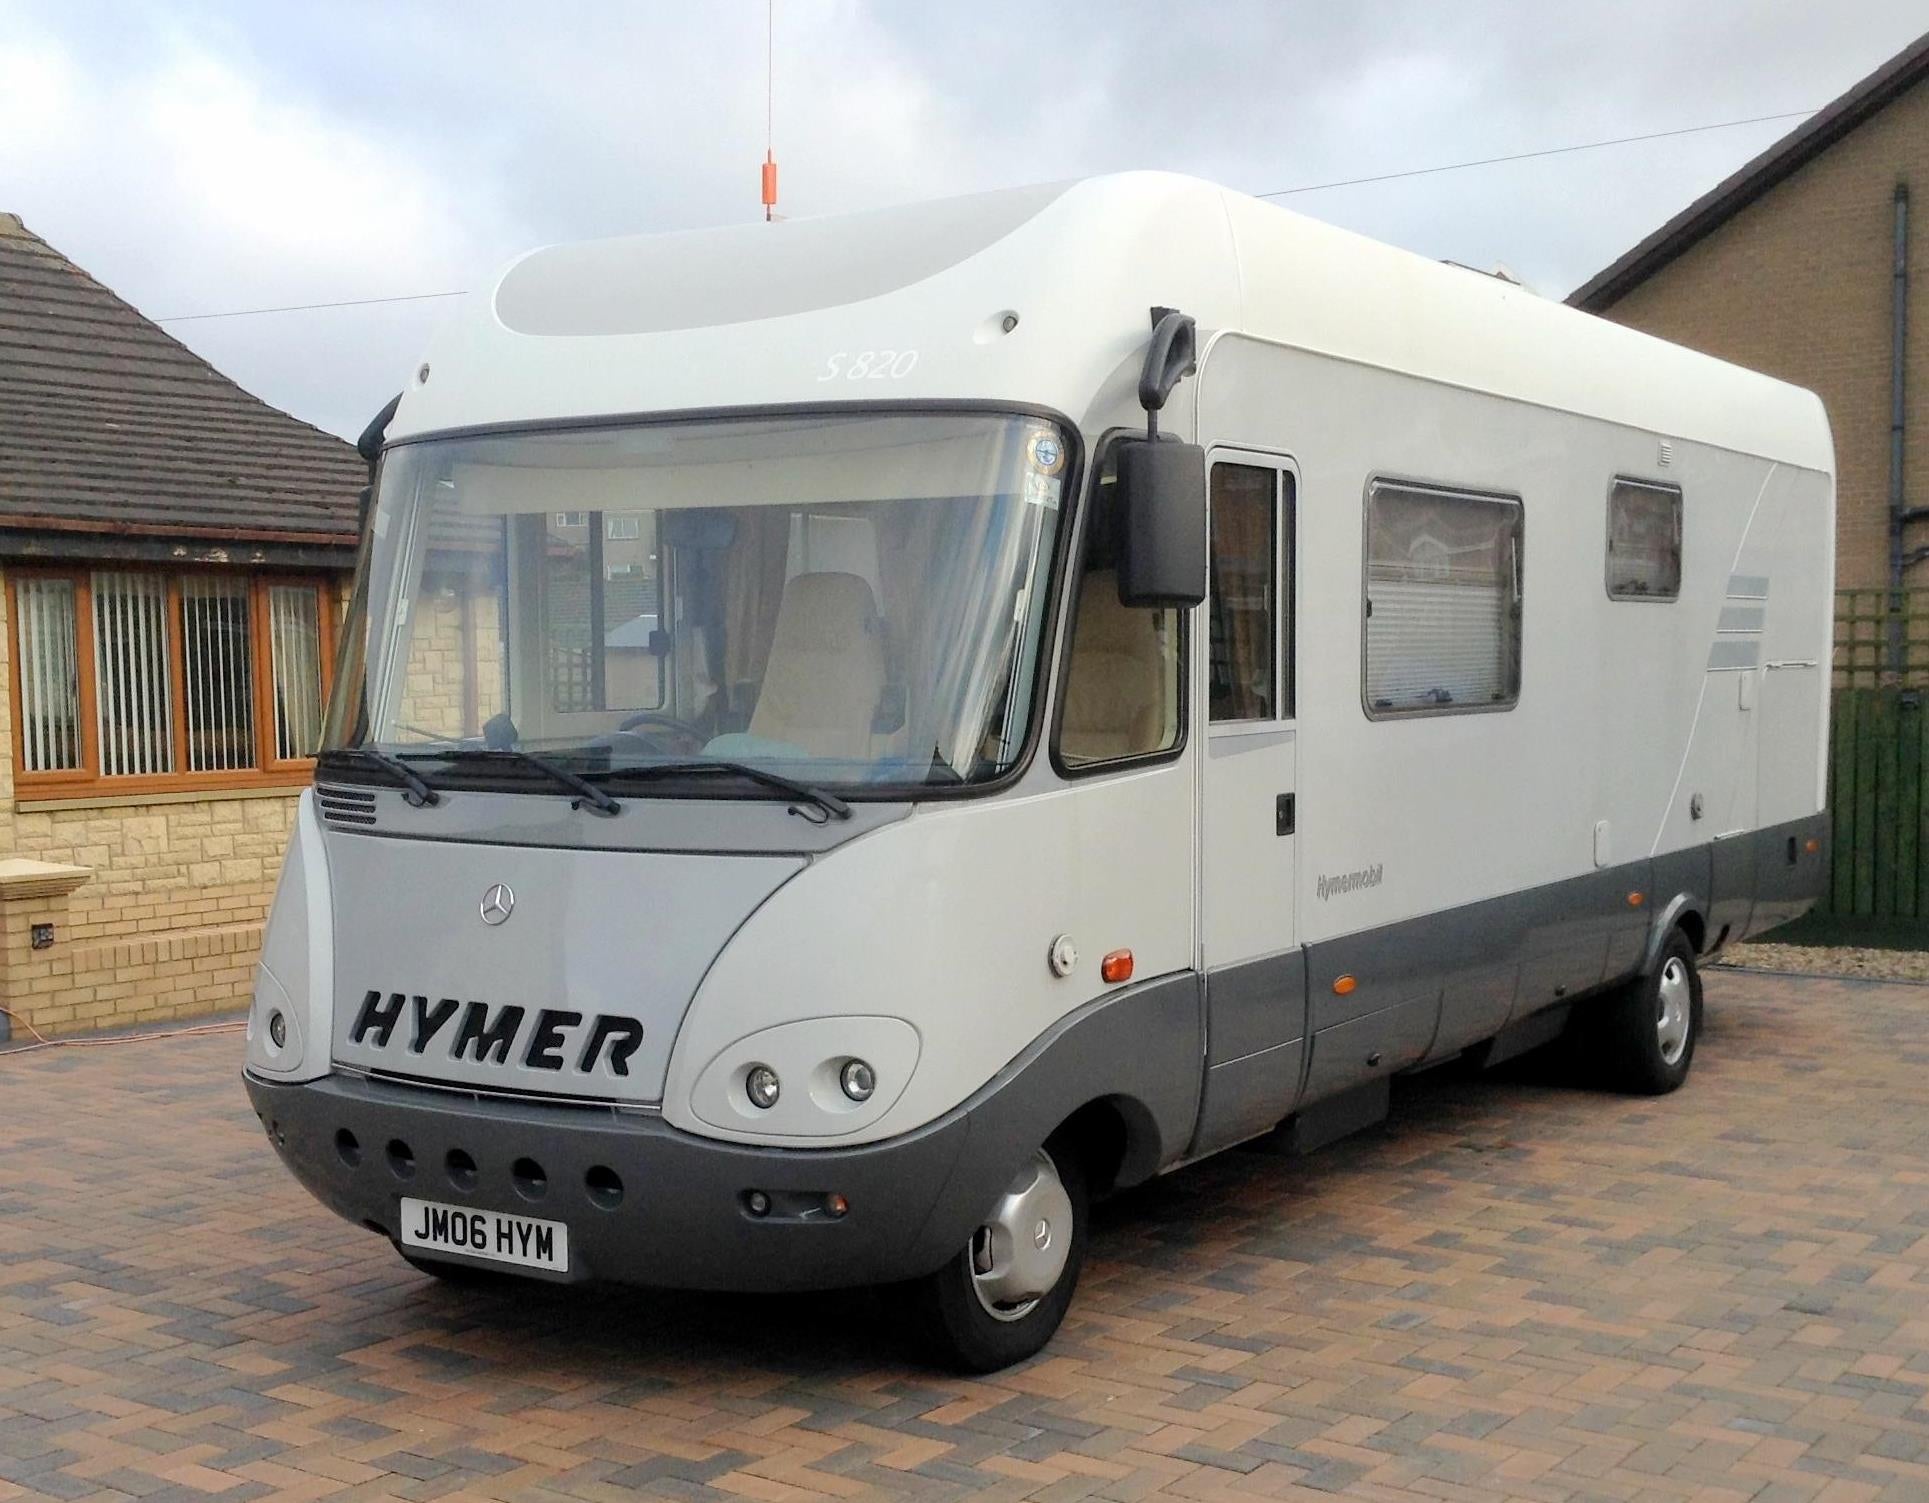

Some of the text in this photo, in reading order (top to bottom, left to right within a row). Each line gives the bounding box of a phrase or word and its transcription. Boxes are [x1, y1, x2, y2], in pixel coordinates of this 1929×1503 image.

[817, 350, 918, 382] S 820
[349, 990, 644, 1078] HYMER
[415, 1206, 553, 1262] JM06 HYM
